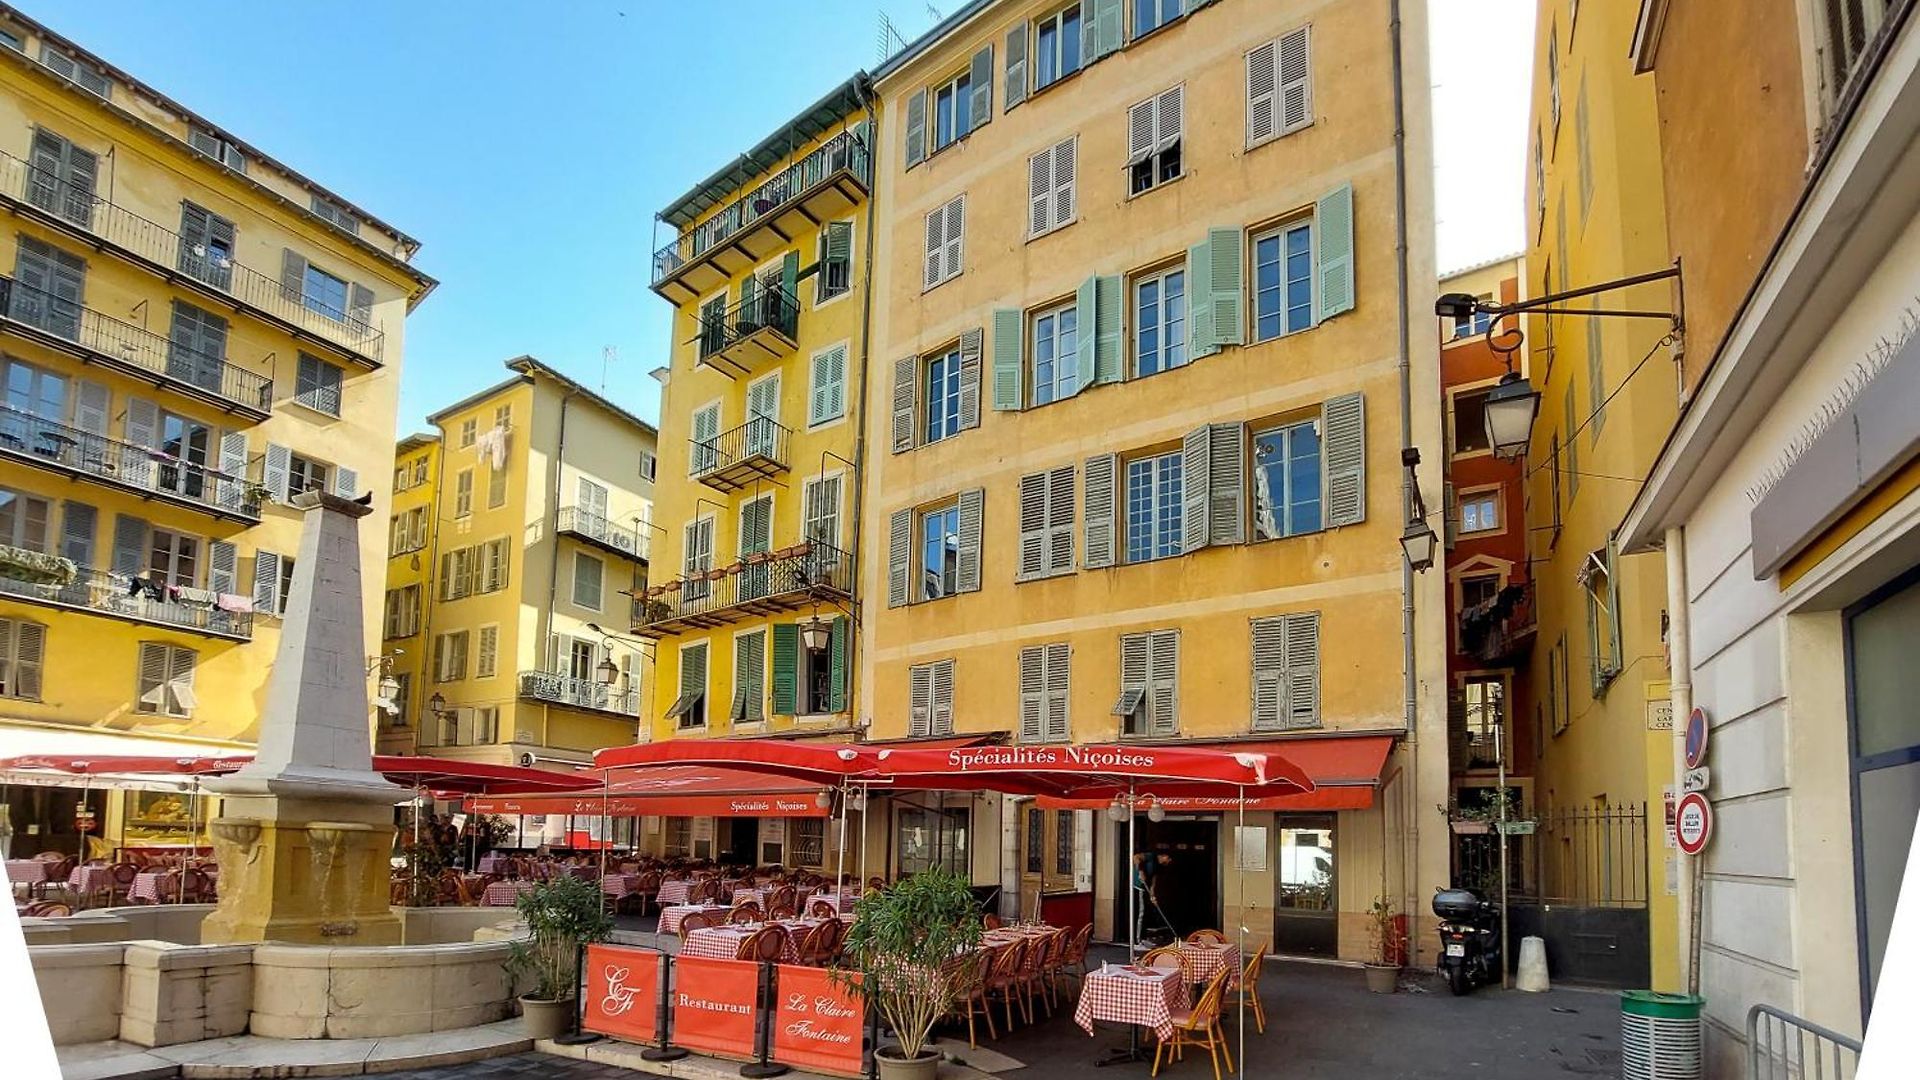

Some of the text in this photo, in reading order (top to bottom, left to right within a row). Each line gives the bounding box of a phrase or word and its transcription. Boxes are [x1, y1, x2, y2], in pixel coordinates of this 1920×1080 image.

[948, 747, 1154, 770] Spécialités Niçoises
[730, 801, 808, 812] Spécialités Niçoises
[1195, 797, 1261, 805] Fontane
[678, 993, 751, 1015] Restaurant
[785, 992, 856, 1018] La Claire
[785, 1019, 852, 1045] Fontaine
